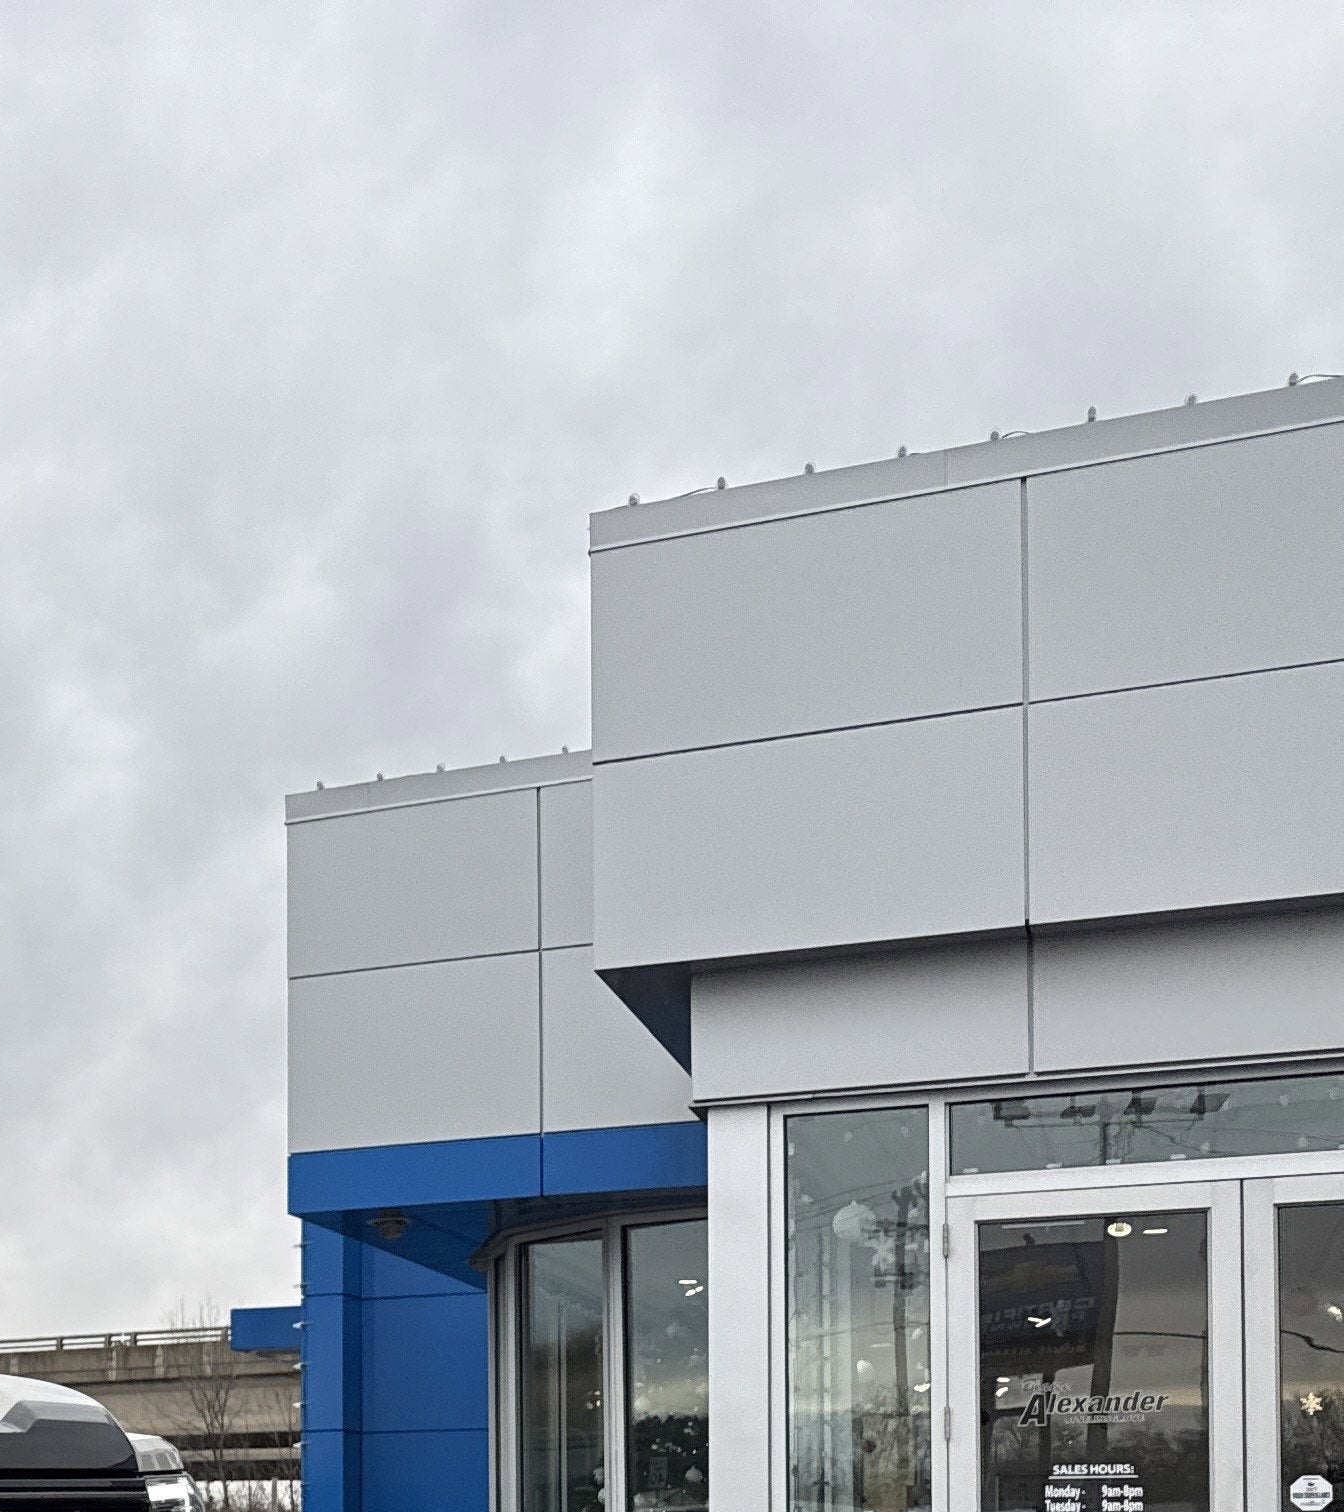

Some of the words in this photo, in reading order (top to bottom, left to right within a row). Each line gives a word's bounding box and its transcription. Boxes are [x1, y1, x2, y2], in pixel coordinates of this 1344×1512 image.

[1017, 1390, 1169, 1427] Alexander
[1053, 1464, 1088, 1475] SALES
[1089, 1464, 1135, 1474] HOURS:
